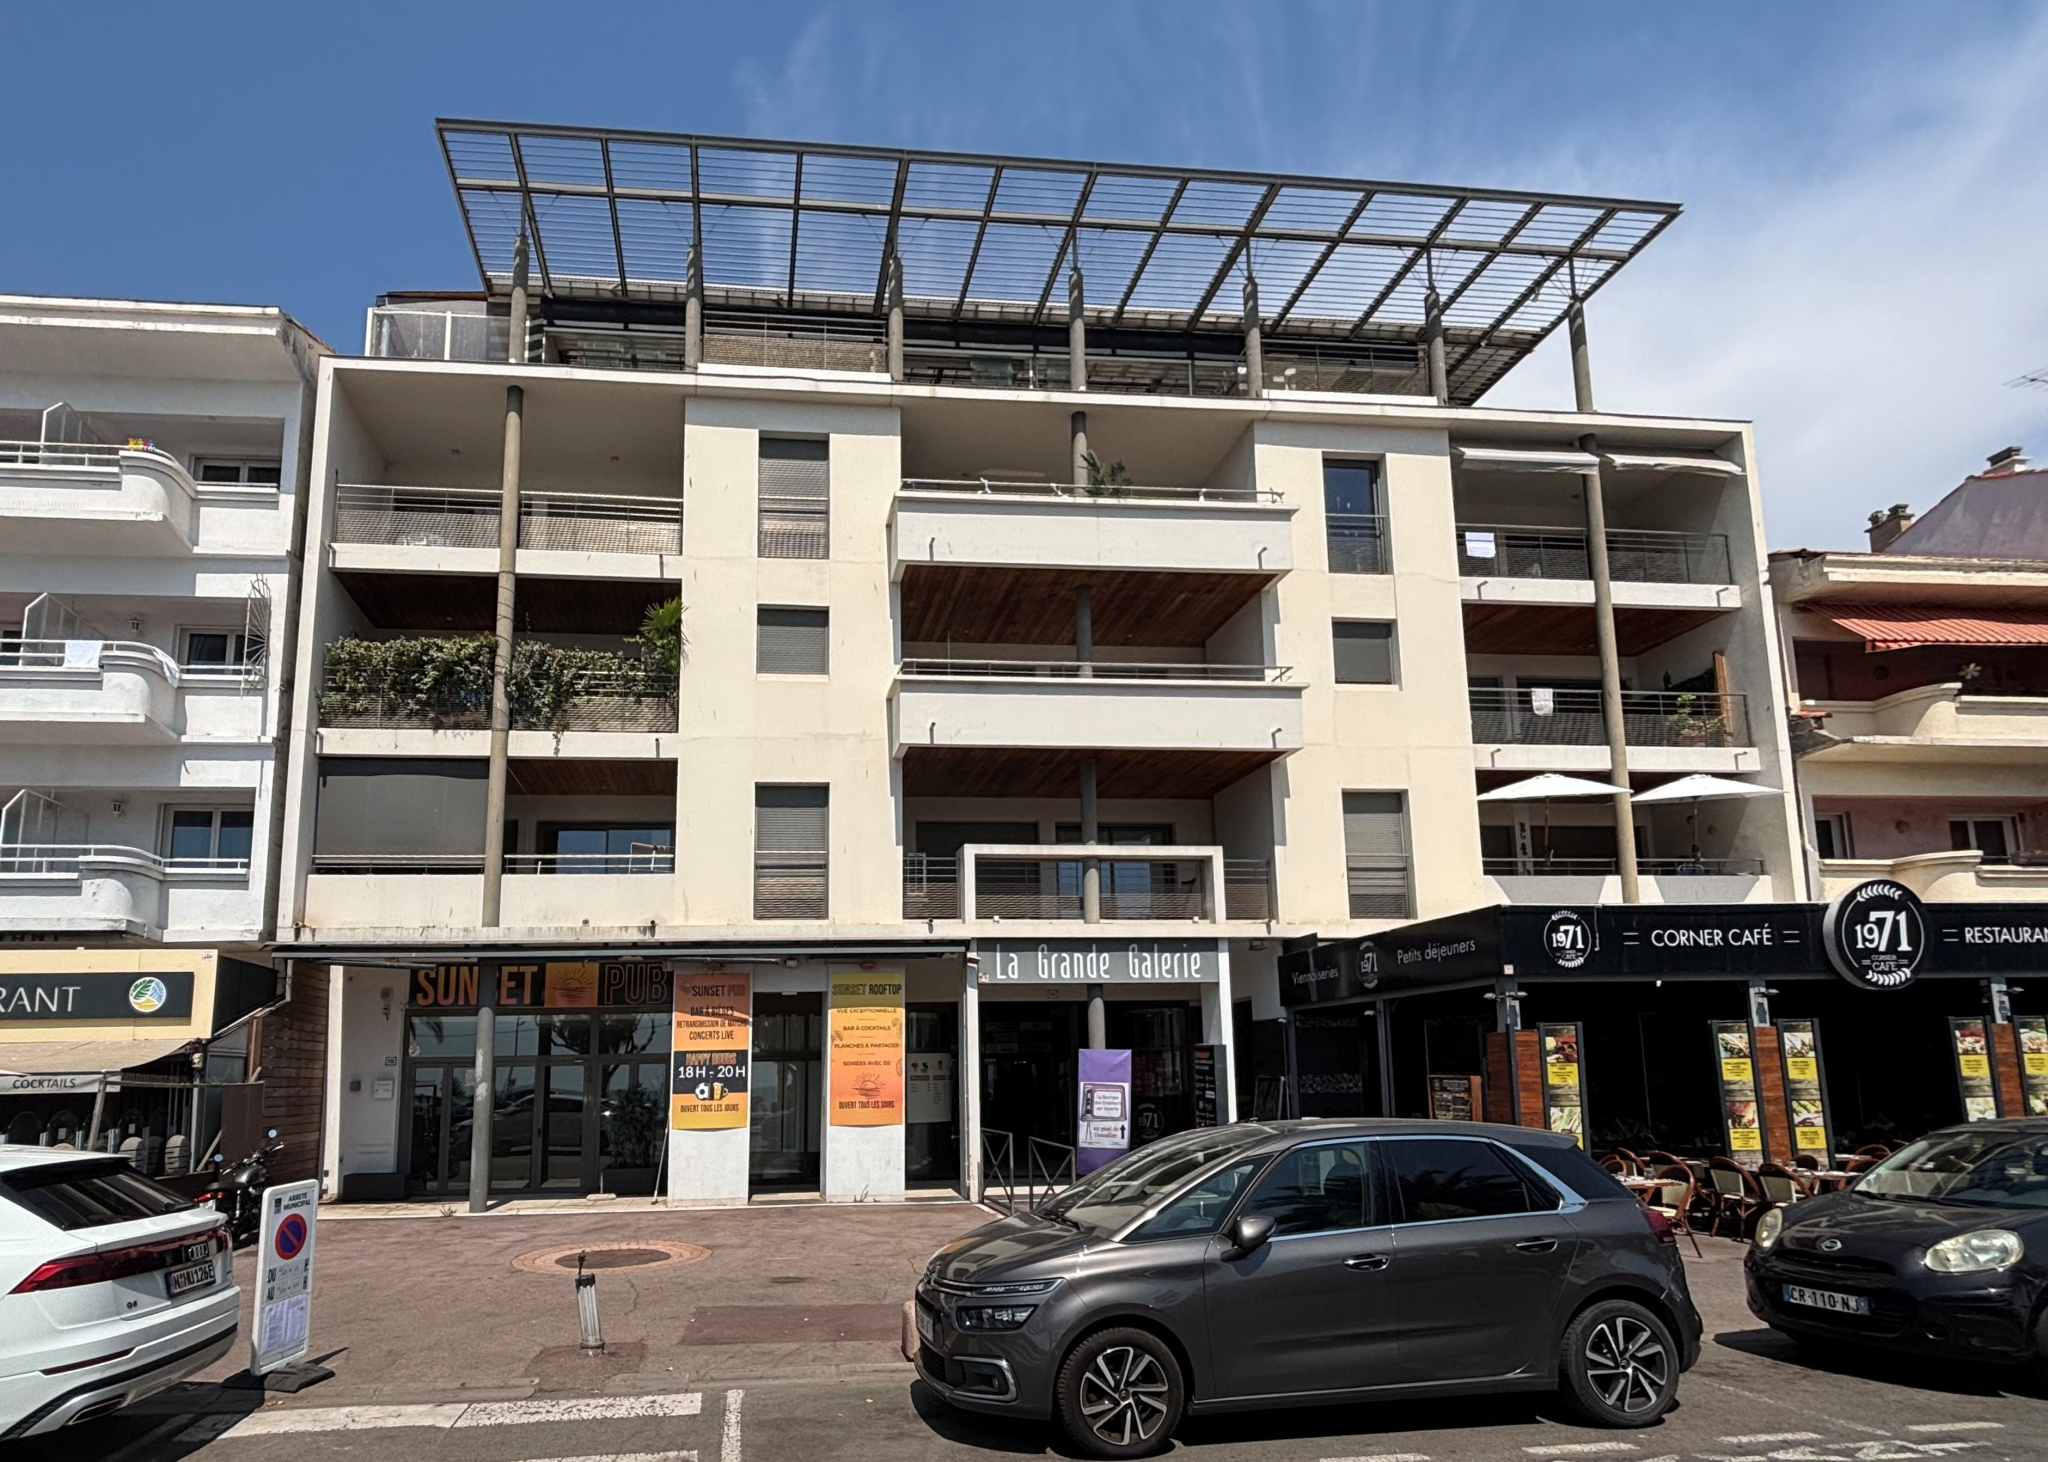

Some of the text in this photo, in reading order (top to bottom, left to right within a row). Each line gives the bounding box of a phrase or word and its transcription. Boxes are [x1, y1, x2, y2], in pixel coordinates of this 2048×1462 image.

[1552, 925, 1585, 949] 1971
[1651, 923, 1773, 947] CORNER CAFÉ
[1854, 911, 1913, 952] 1971
[1397, 939, 1476, 965] Petits déjeuners
[996, 943, 1202, 979] La Grande Galerie
[1360, 952, 1378, 973] 1971
[1291, 967, 1339, 985] Viennoiseries
[416, 964, 668, 1006] SUNET PUB
[692, 985, 726, 997] SUNSET
[832, 984, 902, 996] SUNSET ROOFTOP
[690, 1006, 704, 1016] BAR
[689, 1031, 735, 1041] CONCERTS LIVE
[13, 1078, 76, 1089] COCKTAILS
[680, 1104, 740, 1113] OUVERT TOUS LES JOURS
[839, 1100, 895, 1109] OUVERT TOUS LES SOIRS
[1138, 1112, 1159, 1128] 1971
[283, 1199, 311, 1211] MUNICIPAL
[288, 1192, 308, 1203] ARRETE
[268, 1267, 277, 1284] DU
[267, 1286, 275, 1301] AU
